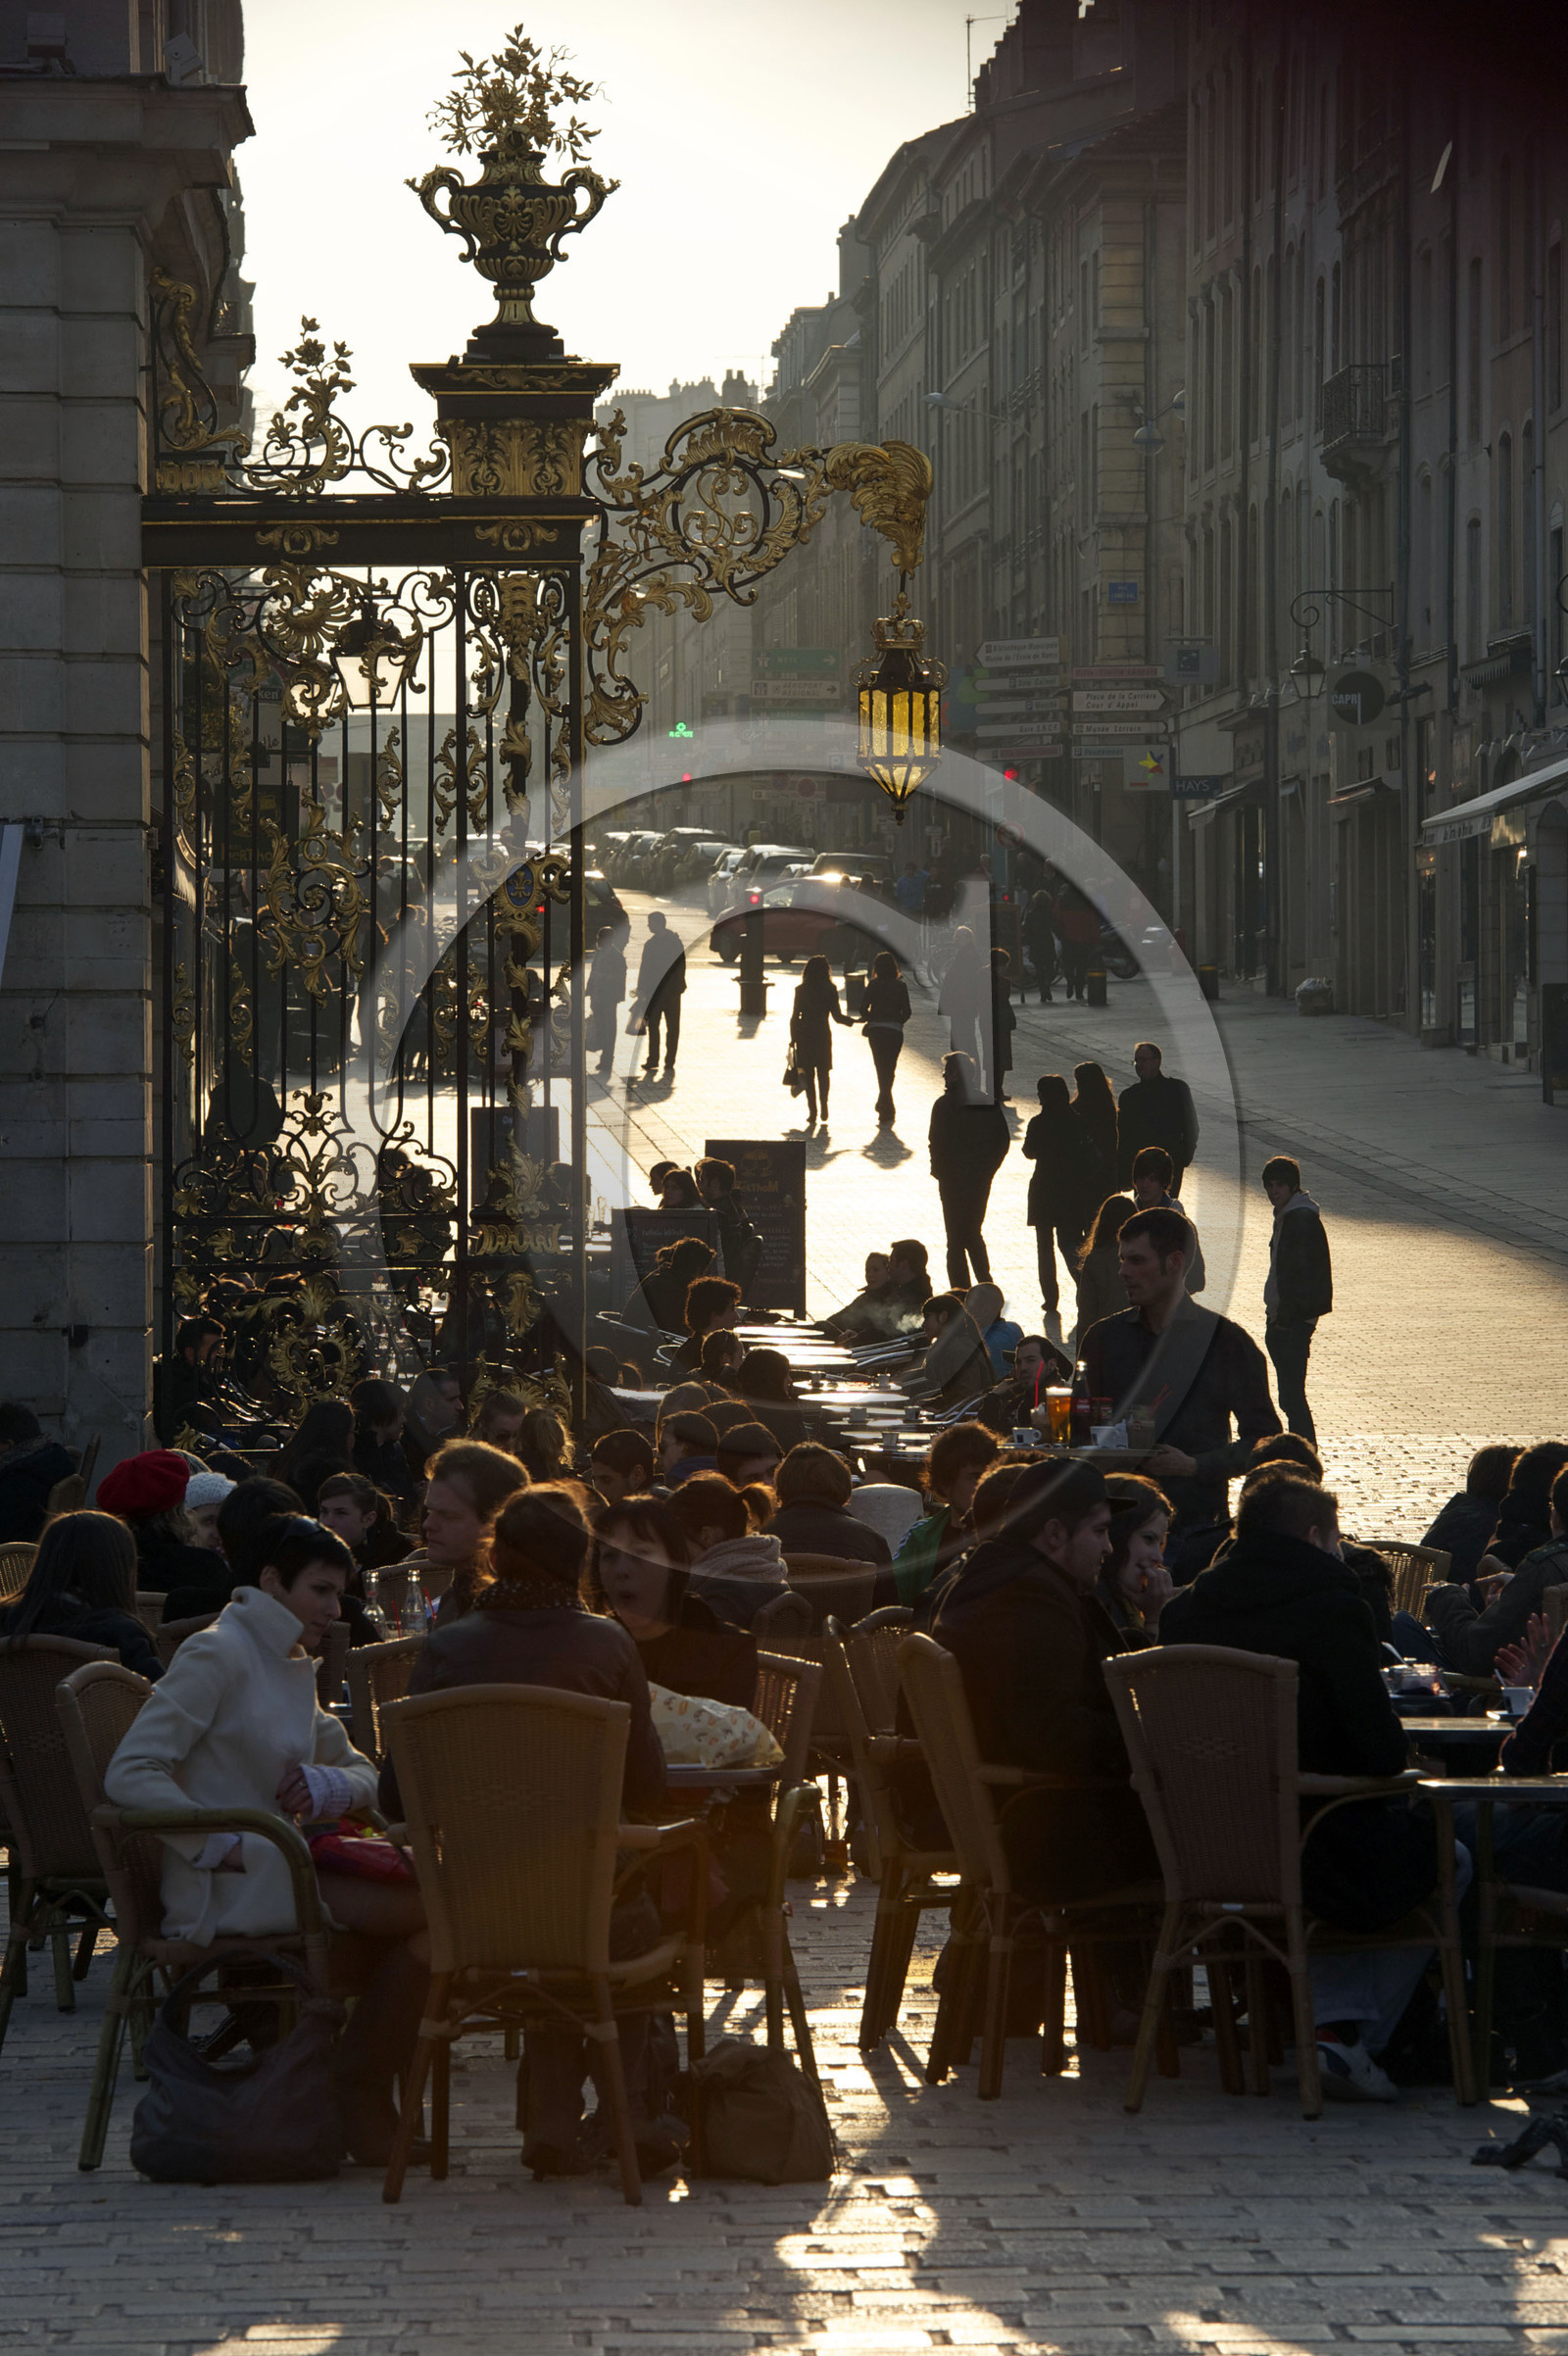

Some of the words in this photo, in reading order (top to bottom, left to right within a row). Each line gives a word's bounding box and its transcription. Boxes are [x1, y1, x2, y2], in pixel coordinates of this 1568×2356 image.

[1086, 692, 1105, 701] Place
[1128, 691, 1157, 700] Carrière
[1086, 701, 1103, 710] Cour
[1086, 724, 1109, 733] Musée
[1114, 723, 1142, 732] Lorrain
[1175, 779, 1210, 792] HAYS
